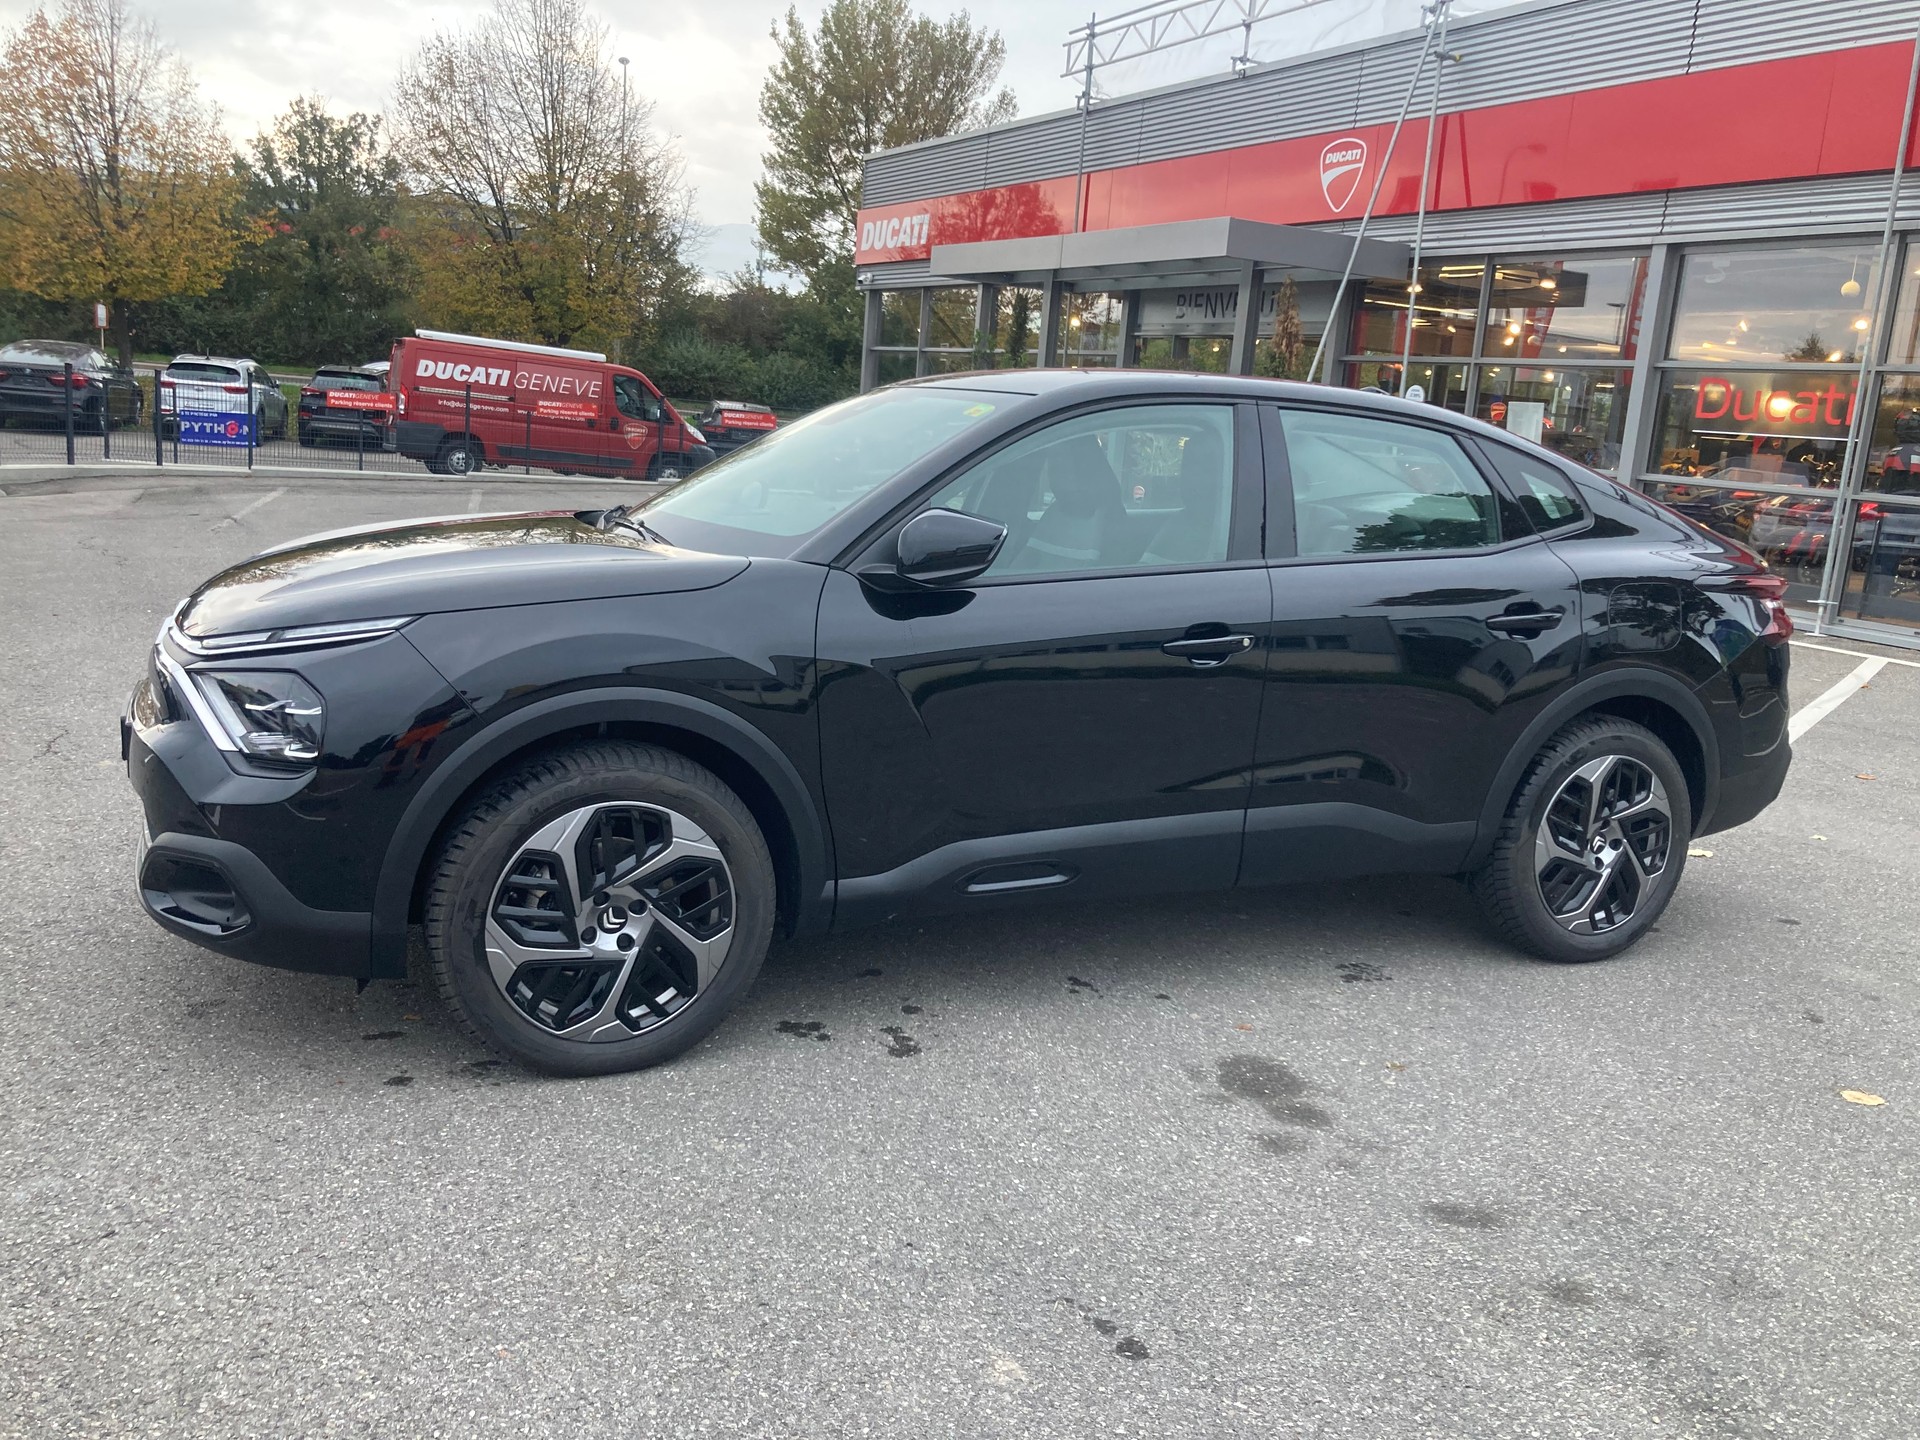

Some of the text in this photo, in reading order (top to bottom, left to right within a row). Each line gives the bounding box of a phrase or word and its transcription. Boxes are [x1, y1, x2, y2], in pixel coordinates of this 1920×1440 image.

[1325, 149, 1362, 165] DUCATI
[860, 213, 931, 252] DUCATI
[415, 359, 603, 399] DUCATI GENEVE
[331, 399, 353, 407] Parking
[375, 401, 393, 409] clients
[539, 407, 559, 415] Parking
[1694, 375, 1858, 427] Ducati
